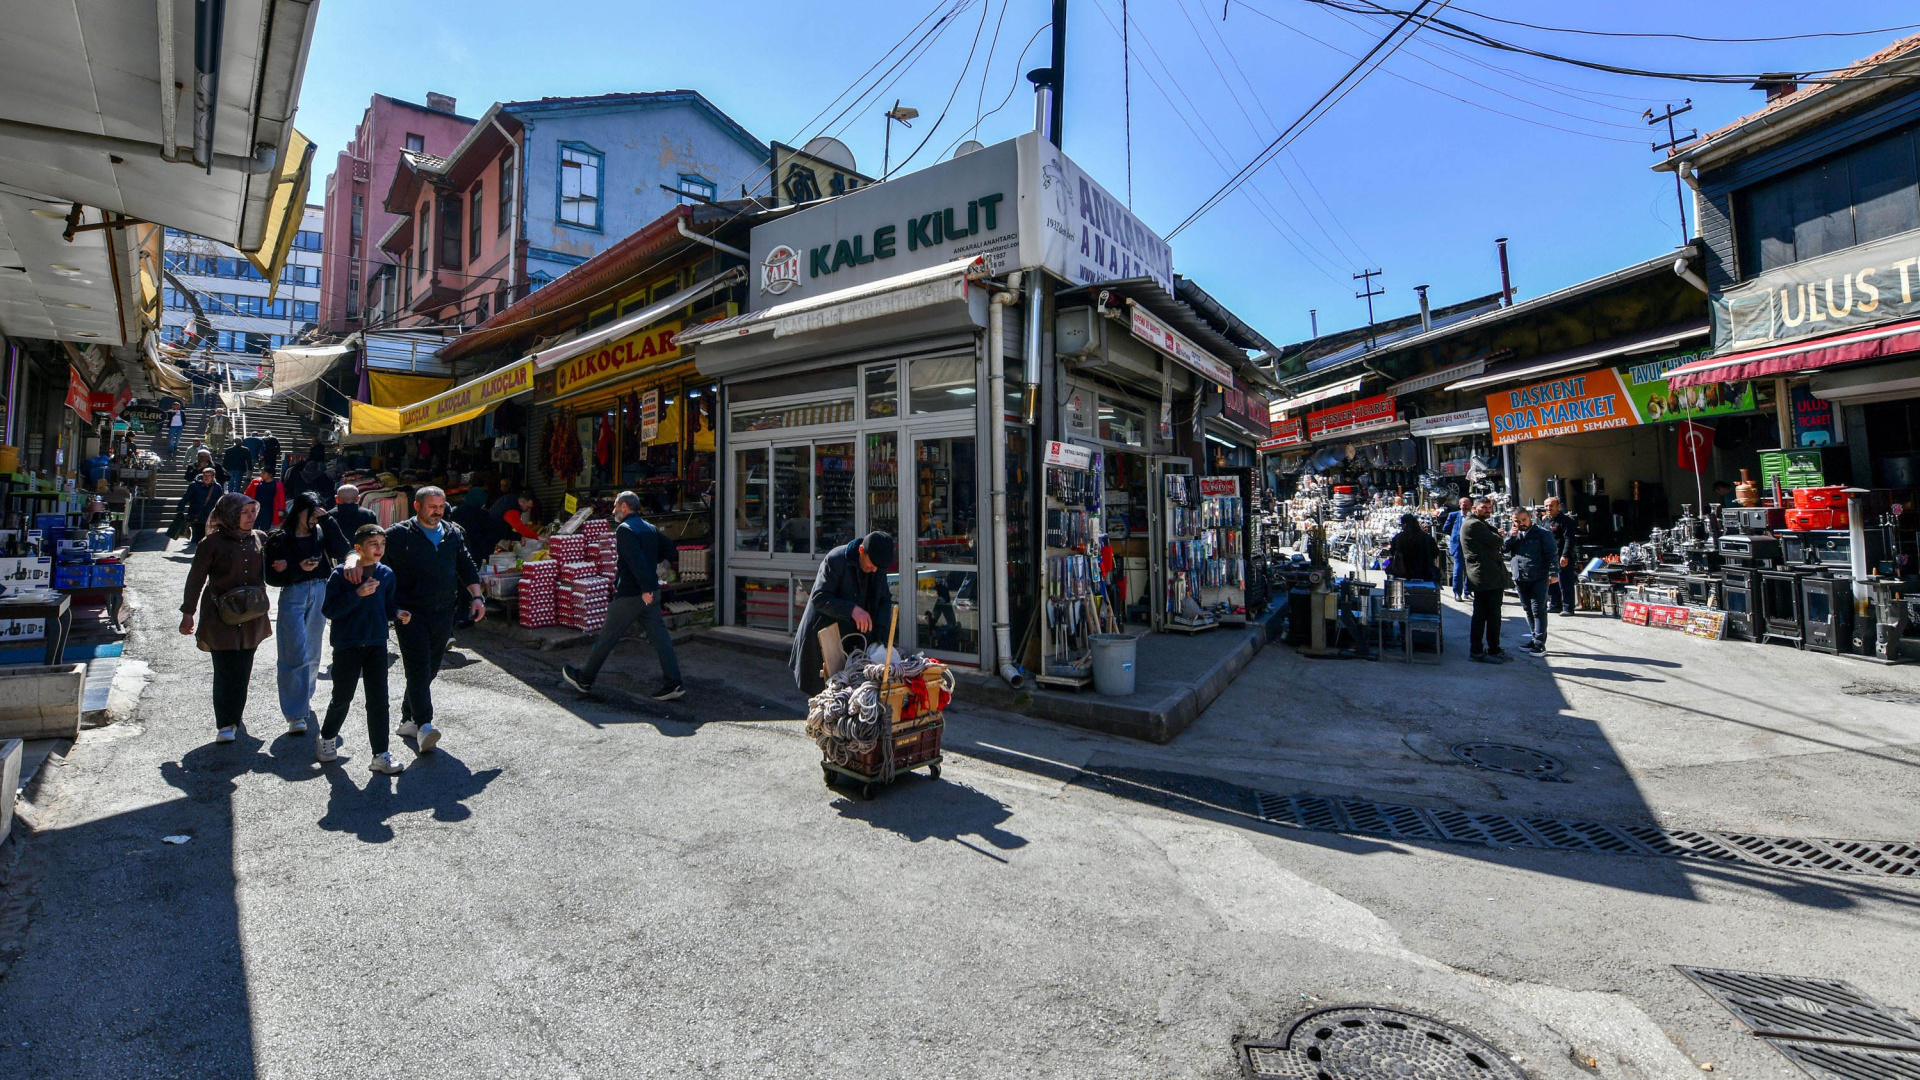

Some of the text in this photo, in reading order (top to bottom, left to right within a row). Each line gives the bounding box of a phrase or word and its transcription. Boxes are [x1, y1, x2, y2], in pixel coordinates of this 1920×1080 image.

[810, 193, 1003, 278] KALE KİLİT
[953, 233, 1018, 254] ANKARALI ANAHTARCI
[760, 250, 802, 296] KALE
[1781, 267, 1879, 328] ULUS
[568, 330, 678, 385] ALKOÇLAR
[1629, 363, 1663, 386] TAVUK
[403, 368, 527, 426] ALKOÇLAR ALKOÇLAR ALKOÇLAR
[1510, 376, 1586, 409] BAŞKENT
[1797, 398, 1829, 412] ULUS
[123, 410, 162, 420] PARLAK
[1354, 399, 1392, 418] TİCARET
[1494, 394, 1616, 434] SOBA MARKET
[1798, 414, 1831, 426] TİCARET
[1498, 417, 1628, 444] MANGAL BARBEKÜ SEMAVER
